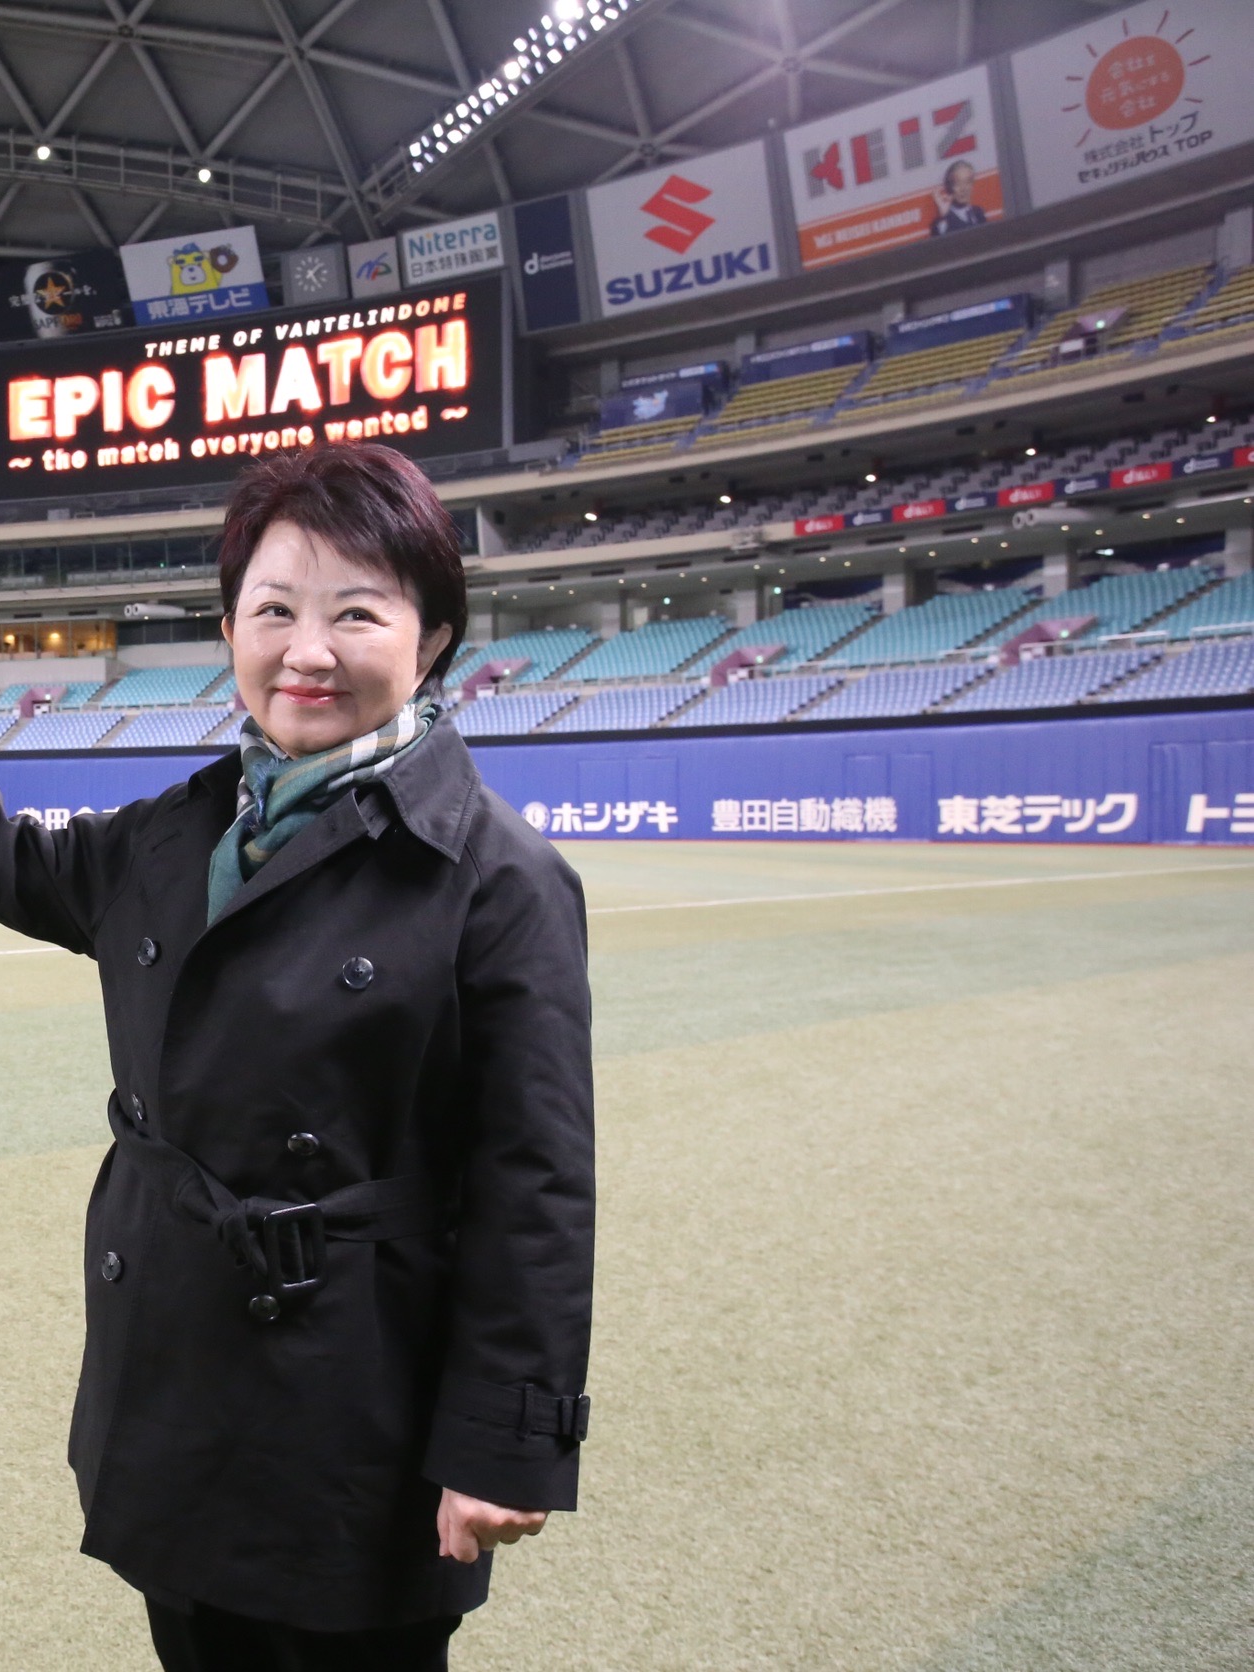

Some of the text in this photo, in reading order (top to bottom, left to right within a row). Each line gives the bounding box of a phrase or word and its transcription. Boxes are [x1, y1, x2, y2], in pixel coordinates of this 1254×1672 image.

[803, 99, 978, 199] KEIZ
[1174, 129, 1213, 152] TOP
[408, 222, 497, 259] Niterra
[605, 242, 771, 306] SUZUKI
[146, 288, 252, 320] 東海テレビ
[145, 293, 466, 358] THEME OF VANTELINDOME
[7, 318, 468, 442] EPIC MATCH
[42, 447, 87, 472] the
[96, 436, 180, 467] match
[190, 424, 314, 457] everyone
[324, 405, 428, 441] wanted
[550, 800, 678, 833] ホシザキ
[711, 797, 898, 833] 豊田自動織機
[937, 793, 1138, 834] 東芝テック
